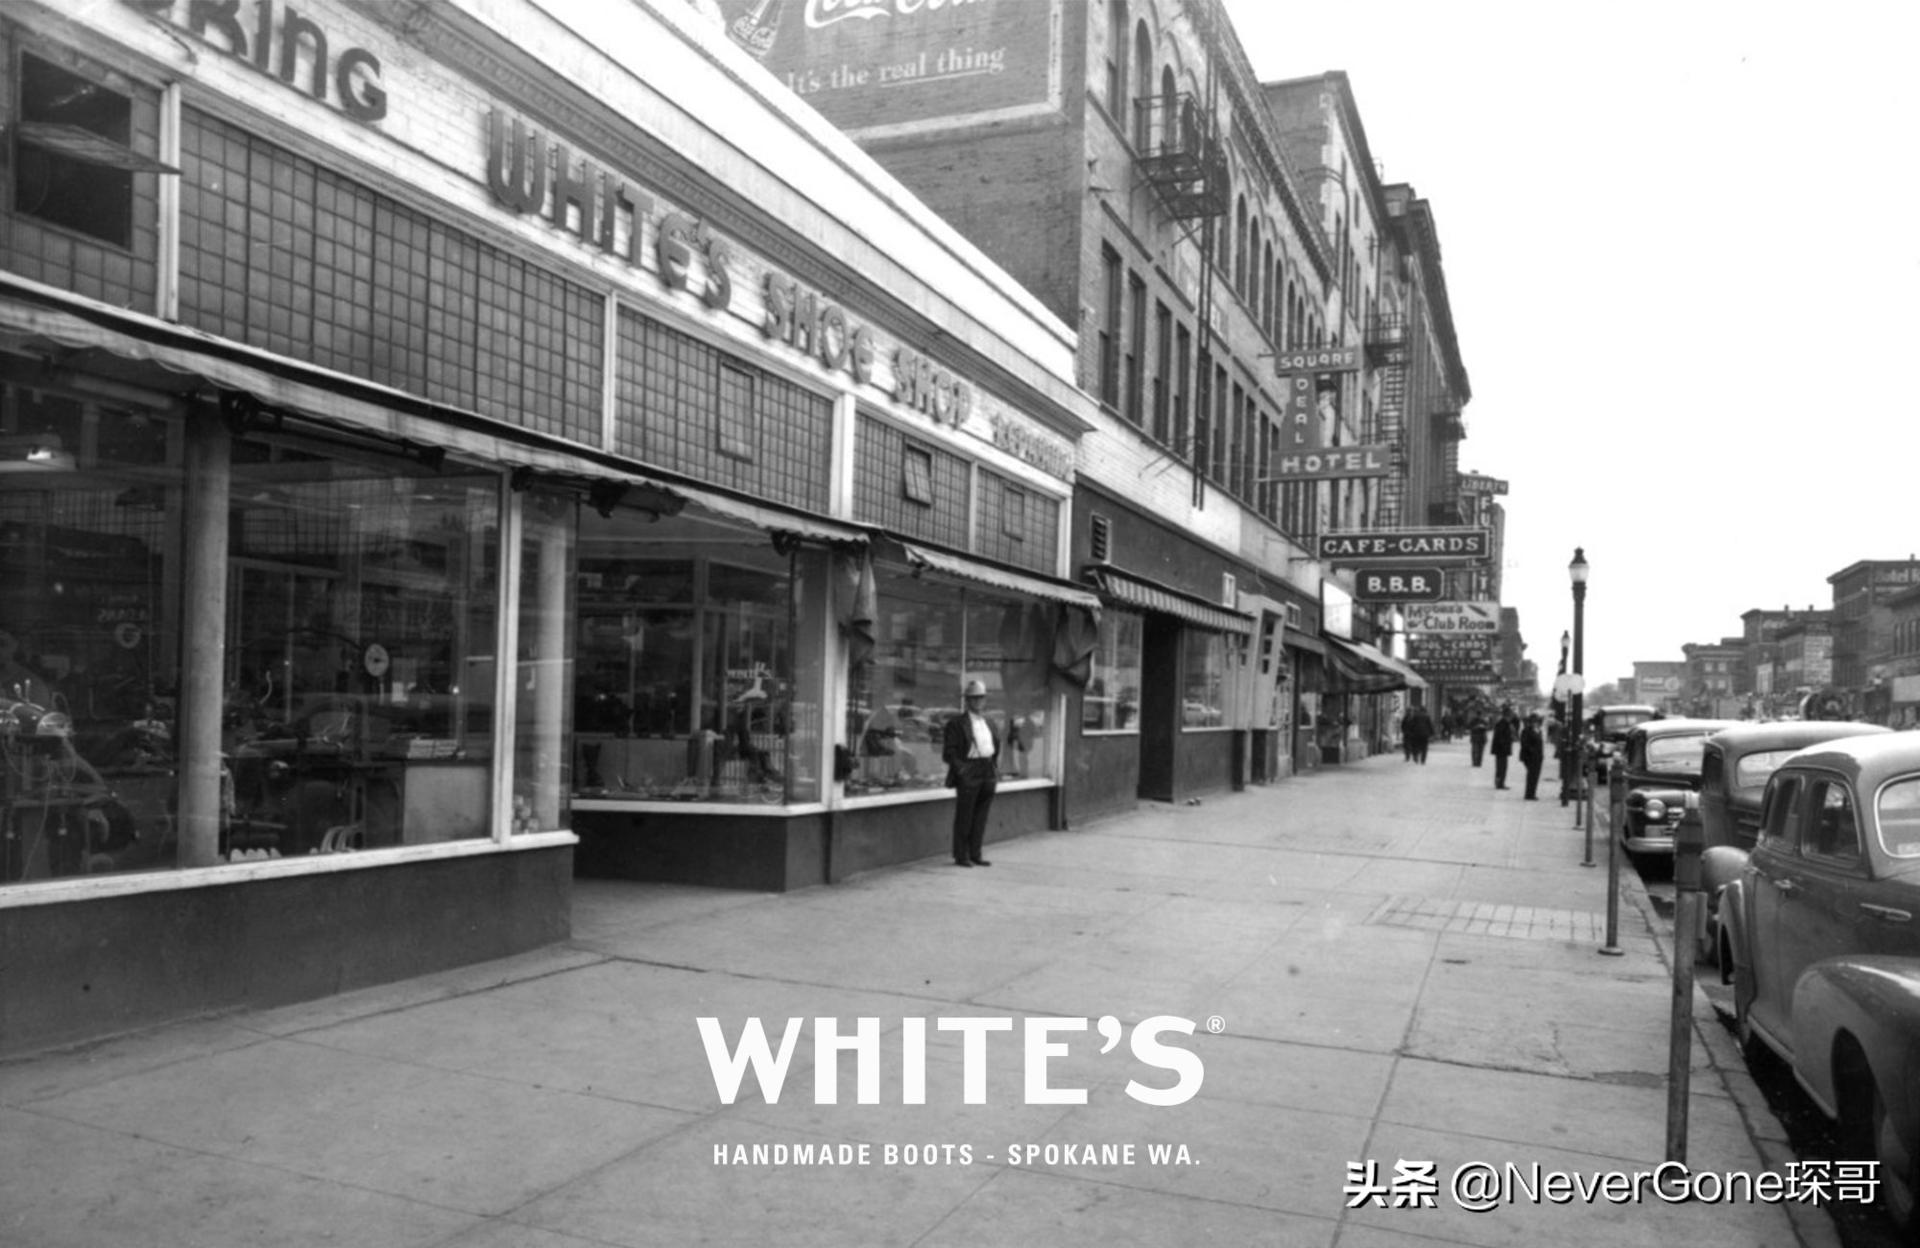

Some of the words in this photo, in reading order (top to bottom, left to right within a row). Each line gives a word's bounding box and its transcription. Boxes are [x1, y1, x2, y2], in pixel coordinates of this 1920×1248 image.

[831, 63, 869, 89] the
[879, 52, 927, 84] real
[937, 47, 1006, 75] thing
[762, 271, 875, 385] SHOE
[892, 349, 972, 431] SHOP
[1280, 351, 1355, 369] SQUARE
[1295, 378, 1309, 443] DEAL
[1281, 451, 1382, 474] HOTEL
[1323, 536, 1480, 554] CAFE-CARDS
[1367, 576, 1432, 593] B.B.B.
[1424, 616, 1455, 630] Club
[1458, 616, 1496, 630] Room
